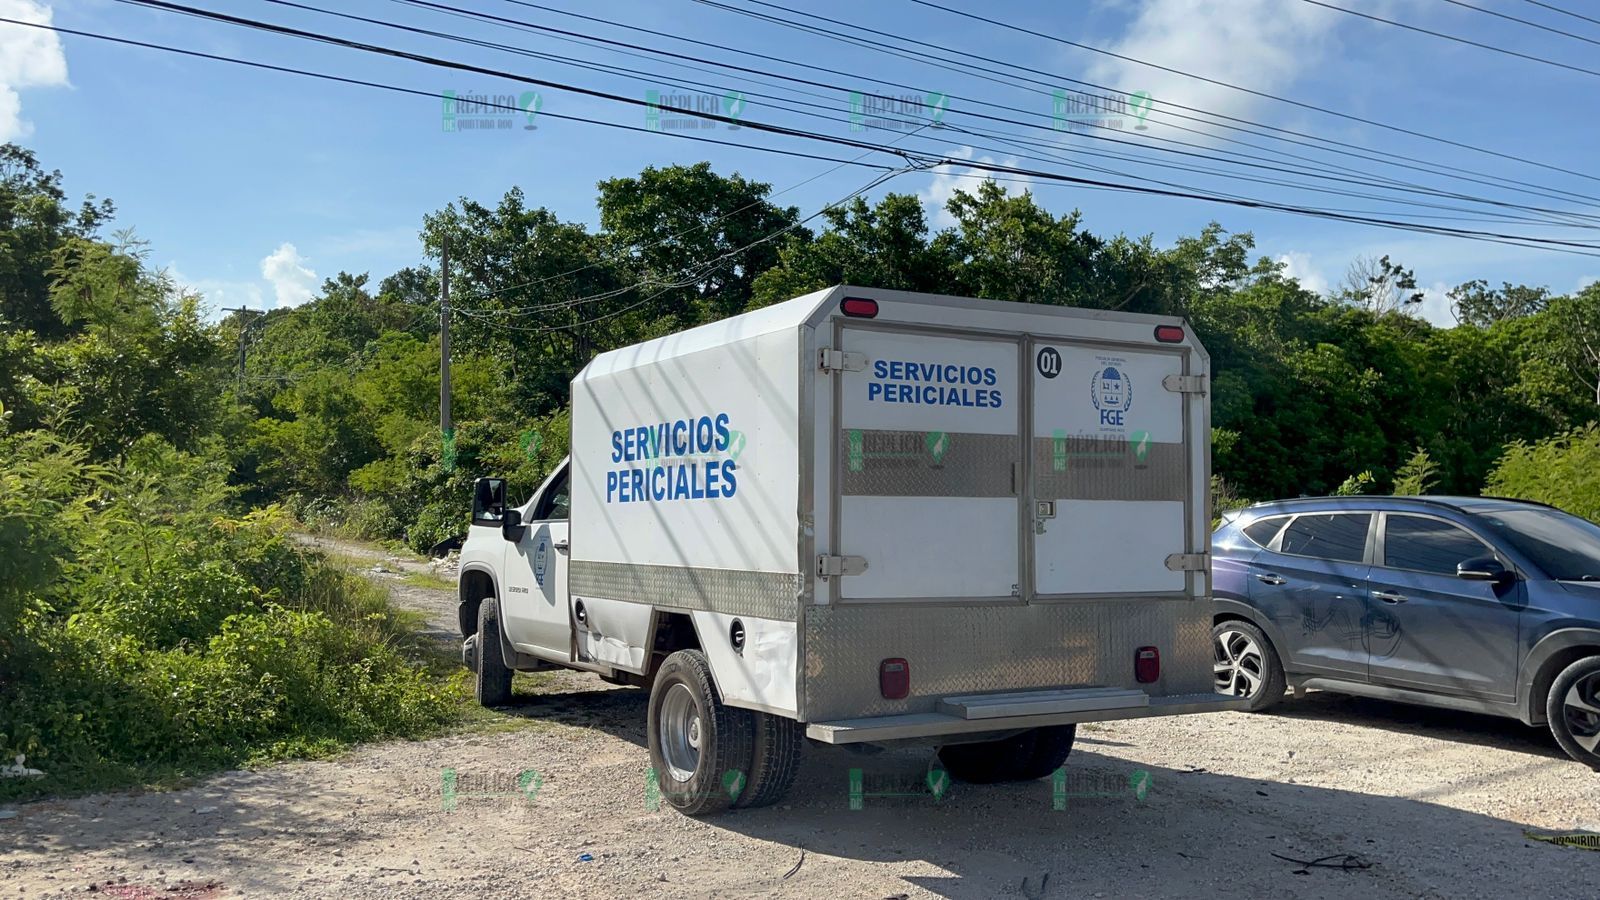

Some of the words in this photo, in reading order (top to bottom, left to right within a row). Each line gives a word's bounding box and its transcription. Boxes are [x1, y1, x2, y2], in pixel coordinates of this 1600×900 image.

[874, 360, 997, 385] SERVICIOS
[1041, 352, 1057, 373] 01
[868, 382, 1002, 408] PERICIALES
[1101, 409, 1123, 425] FGE
[612, 413, 729, 463] SERVICIOS
[607, 459, 737, 503] PERICIALES
